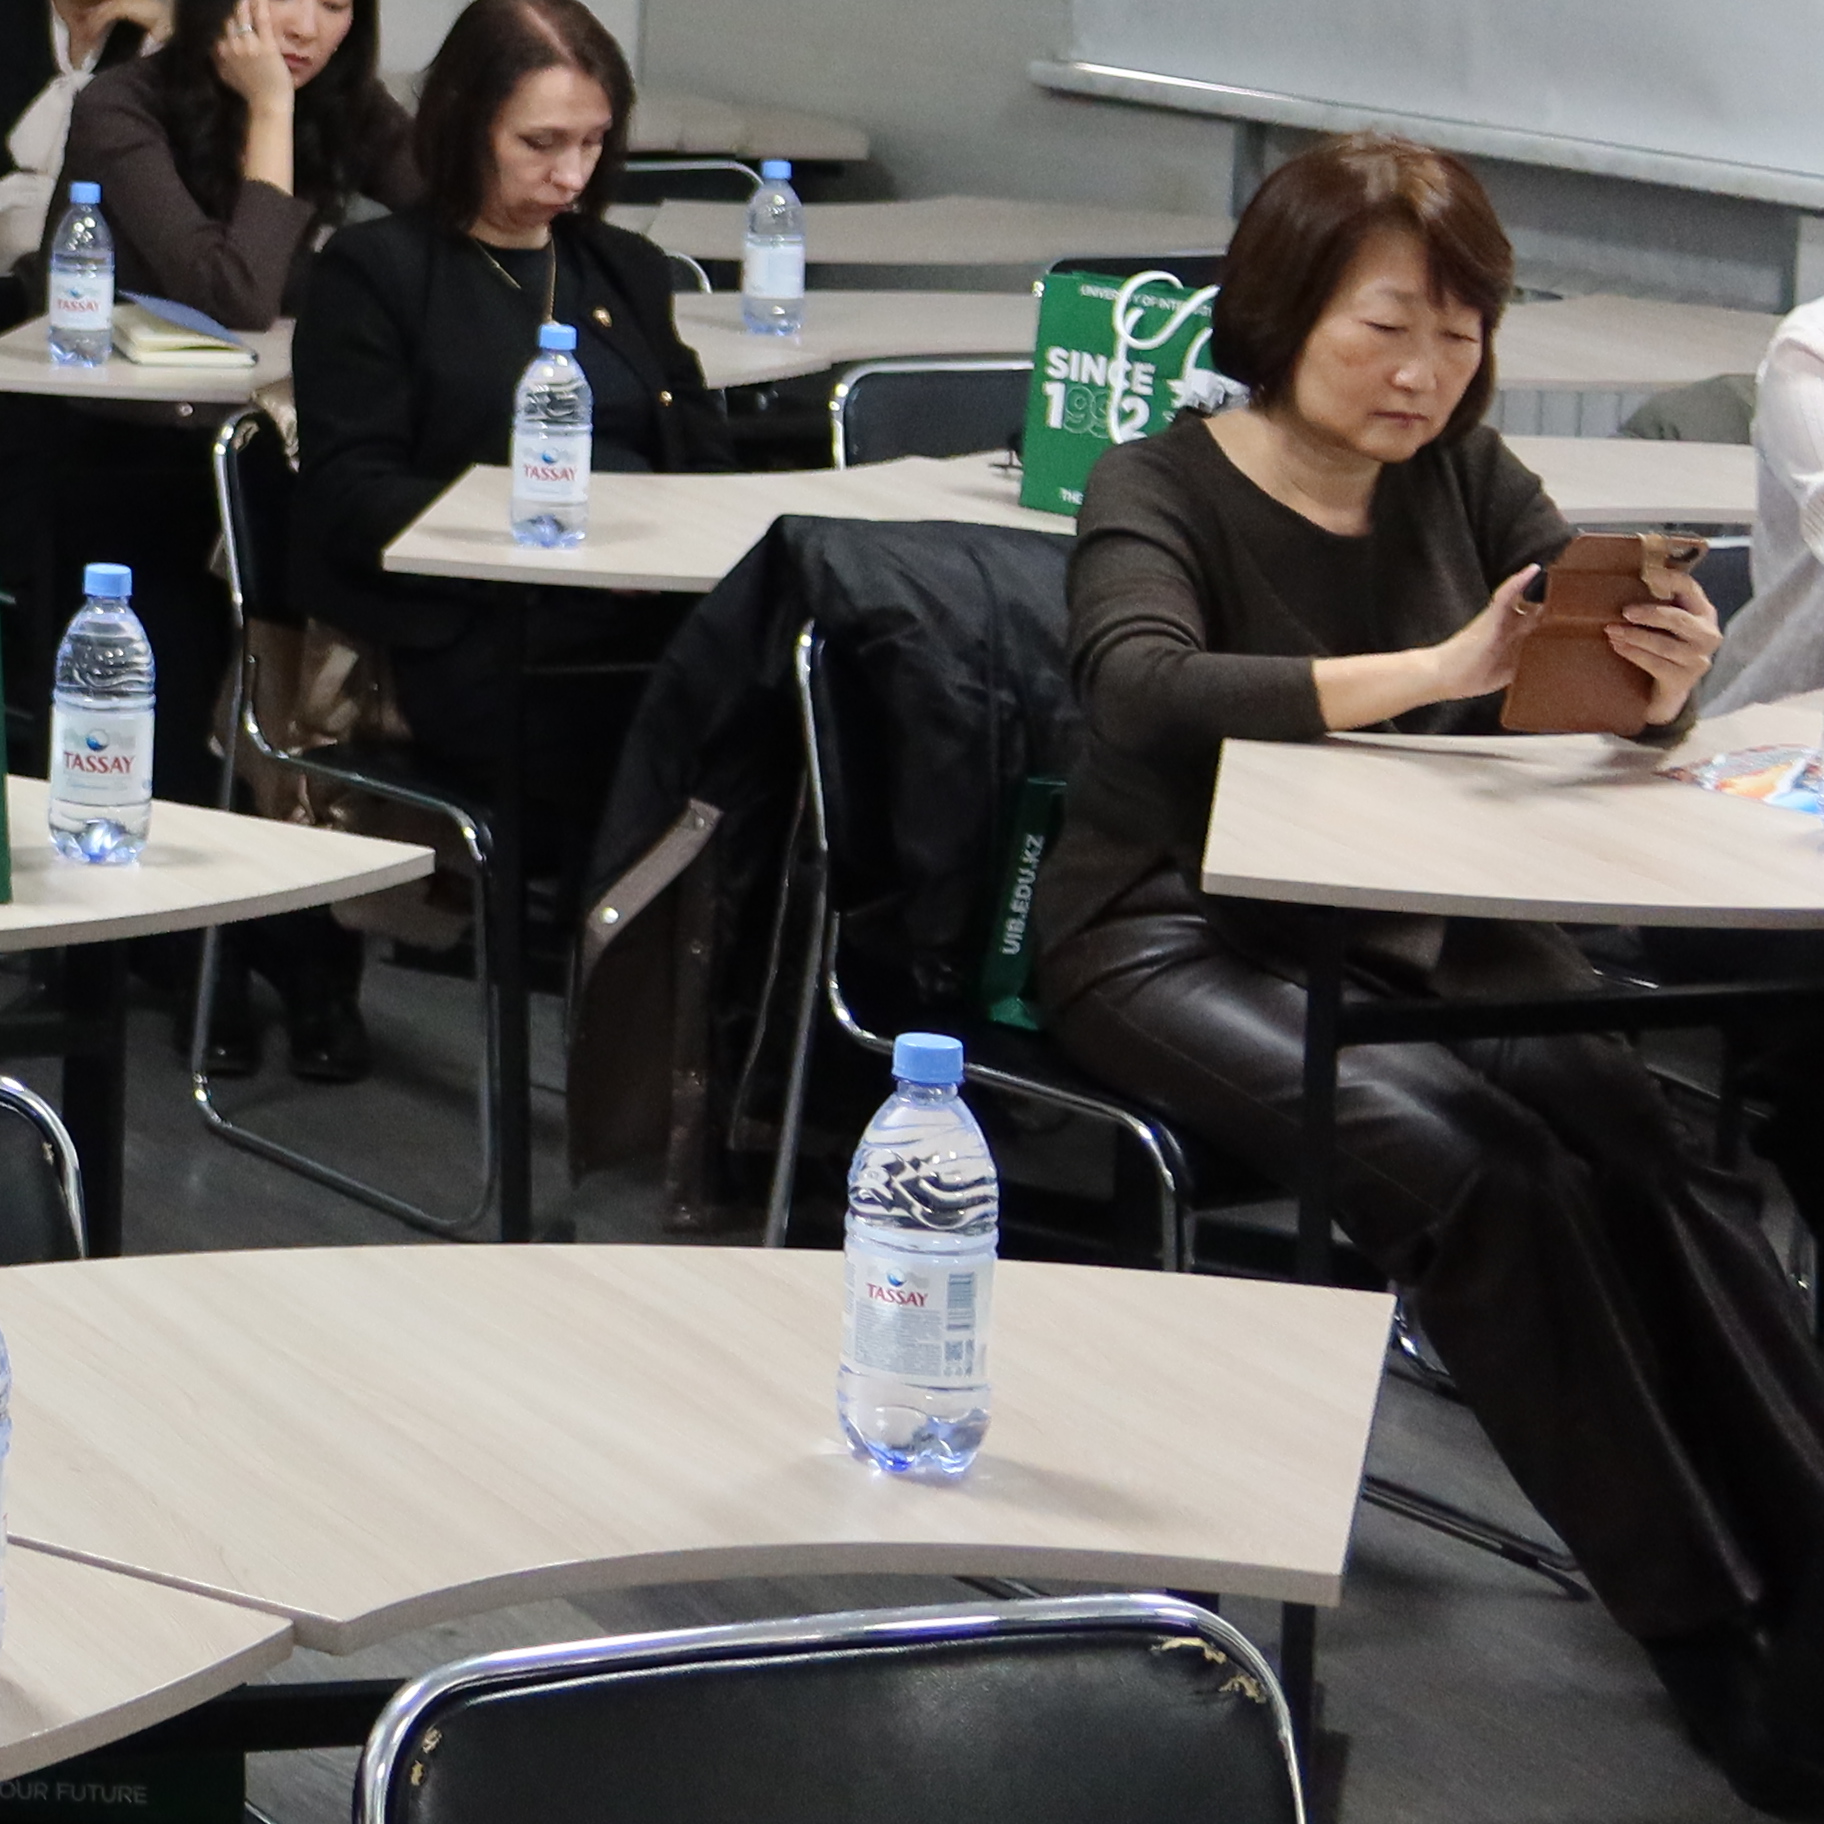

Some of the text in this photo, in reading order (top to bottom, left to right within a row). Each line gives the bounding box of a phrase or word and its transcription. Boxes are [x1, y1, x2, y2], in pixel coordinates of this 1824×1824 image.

[523, 463, 578, 482] TASSAY
[63, 751, 136, 774] TASSAY
[1003, 834, 1045, 955] UIB.EDU.KZ
[866, 1283, 928, 1307] TASSAY
[56, 1782, 149, 1804] FUTURE
